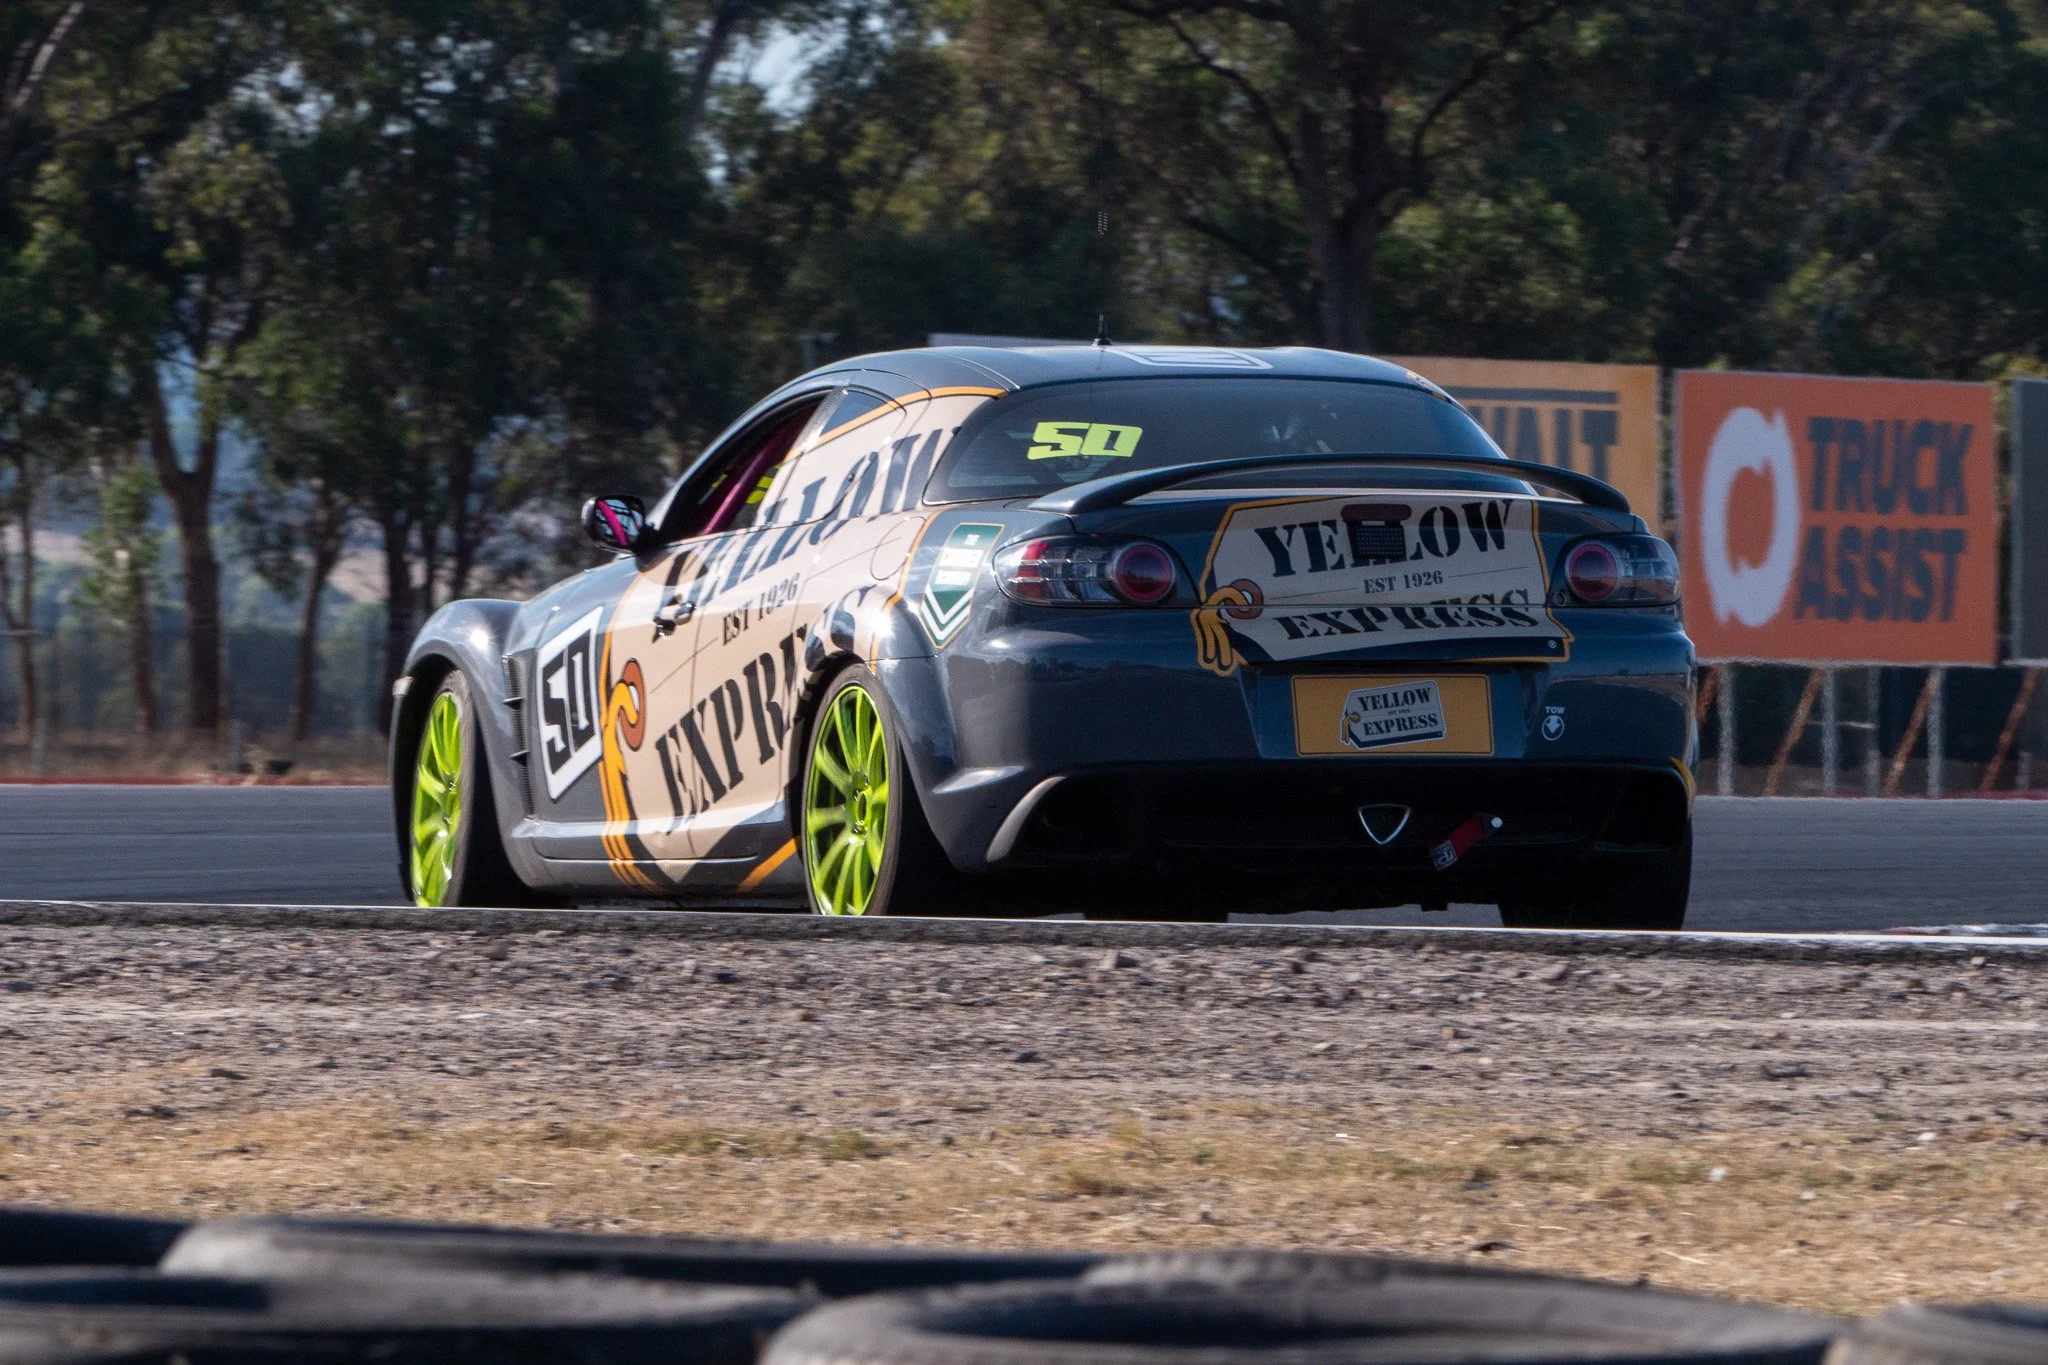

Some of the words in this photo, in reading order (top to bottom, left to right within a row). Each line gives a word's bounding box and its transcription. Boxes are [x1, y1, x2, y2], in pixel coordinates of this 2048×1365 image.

[1027, 421, 1143, 460] 50
[1808, 416, 1973, 516] TRUCK
[1363, 576, 1397, 594] EST
[1403, 570, 1443, 590] 1926
[1793, 525, 1966, 623] ASSIST
[722, 599, 753, 645] EST
[758, 573, 800, 621] 1926
[1273, 588, 1538, 640] EXPRESS
[542, 628, 596, 775] 50
[1357, 687, 1431, 712] YELLOW
[1545, 706, 1565, 714] TOW
[1362, 712, 1438, 737] EXPRESS
